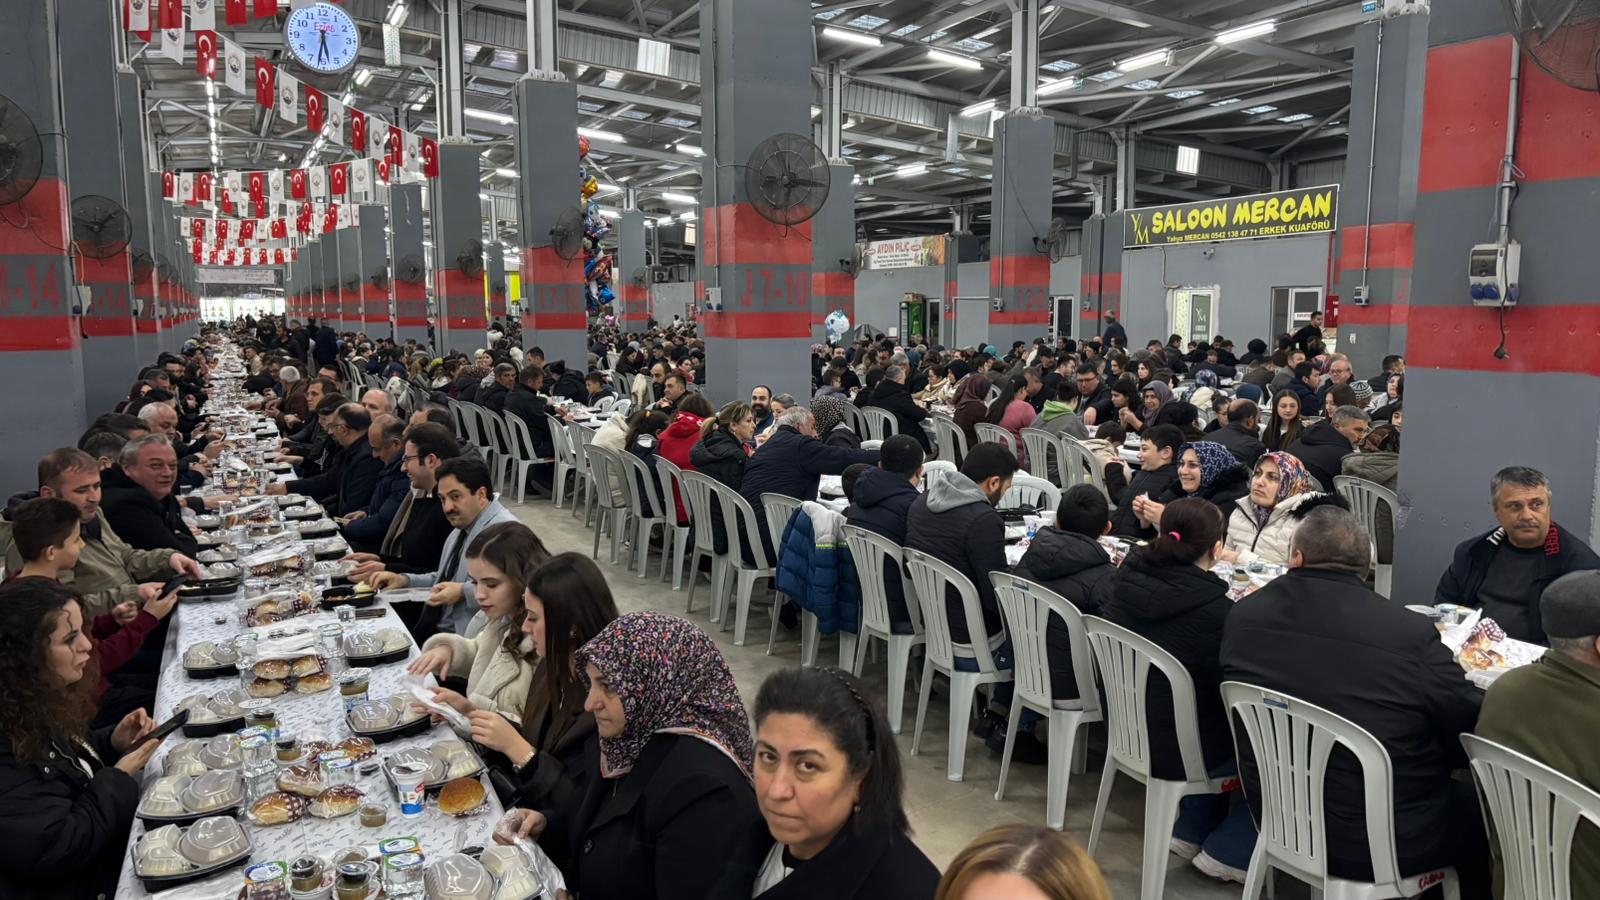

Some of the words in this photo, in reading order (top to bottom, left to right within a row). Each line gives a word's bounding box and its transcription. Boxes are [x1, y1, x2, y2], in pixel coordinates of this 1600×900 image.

[297, 20, 308, 28] 10
[341, 25, 348, 33] 2
[293, 31, 300, 39] 9
[346, 37, 352, 45] 3
[299, 43, 306, 51] 8
[1151, 202, 1228, 234] SALOON
[1232, 190, 1332, 226] MERCAN
[1184, 232, 1210, 241] MERCAN
[1211, 231, 1226, 239] 0542
[1239, 229, 1248, 237] 47
[1259, 225, 1287, 235] ERKEK
[1288, 219, 1330, 233] KUAFÖRÜ
